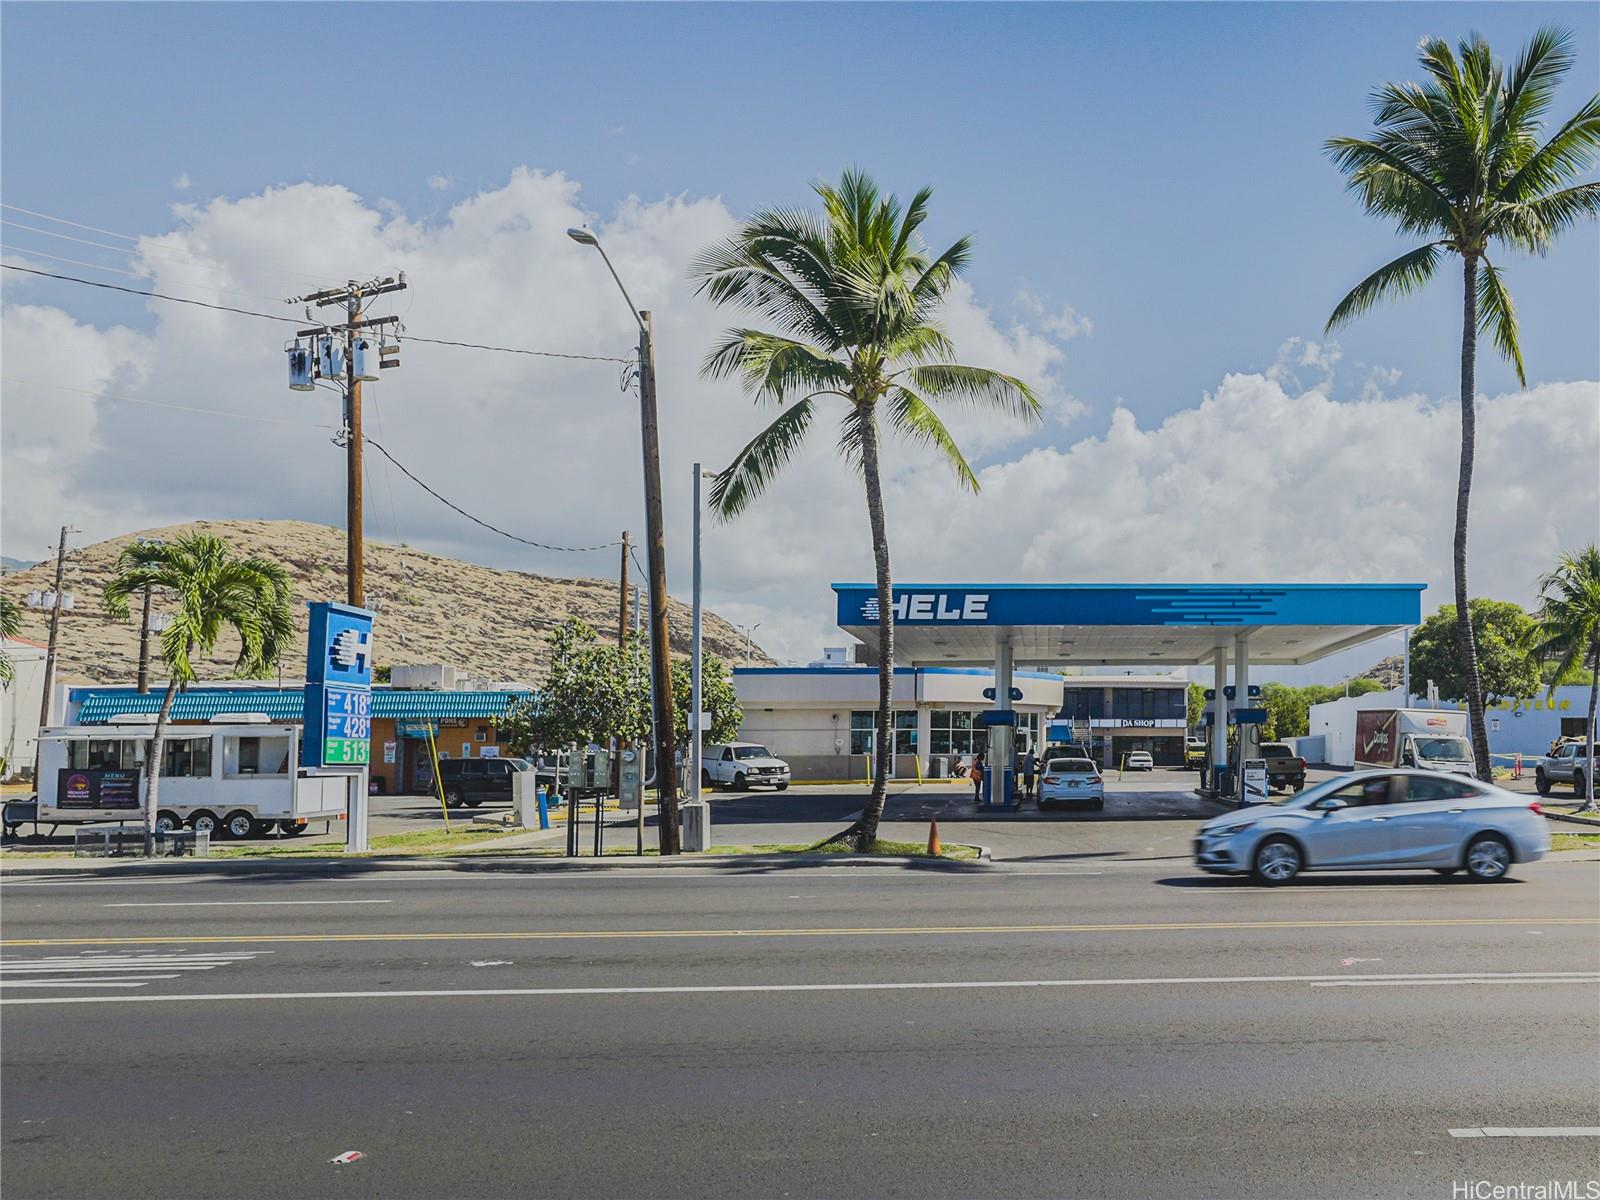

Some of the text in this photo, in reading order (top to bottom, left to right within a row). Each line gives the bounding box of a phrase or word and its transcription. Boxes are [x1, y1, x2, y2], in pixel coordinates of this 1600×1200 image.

[876, 594, 989, 620] HELE
[1122, 719, 1155, 728] DA SHOP
